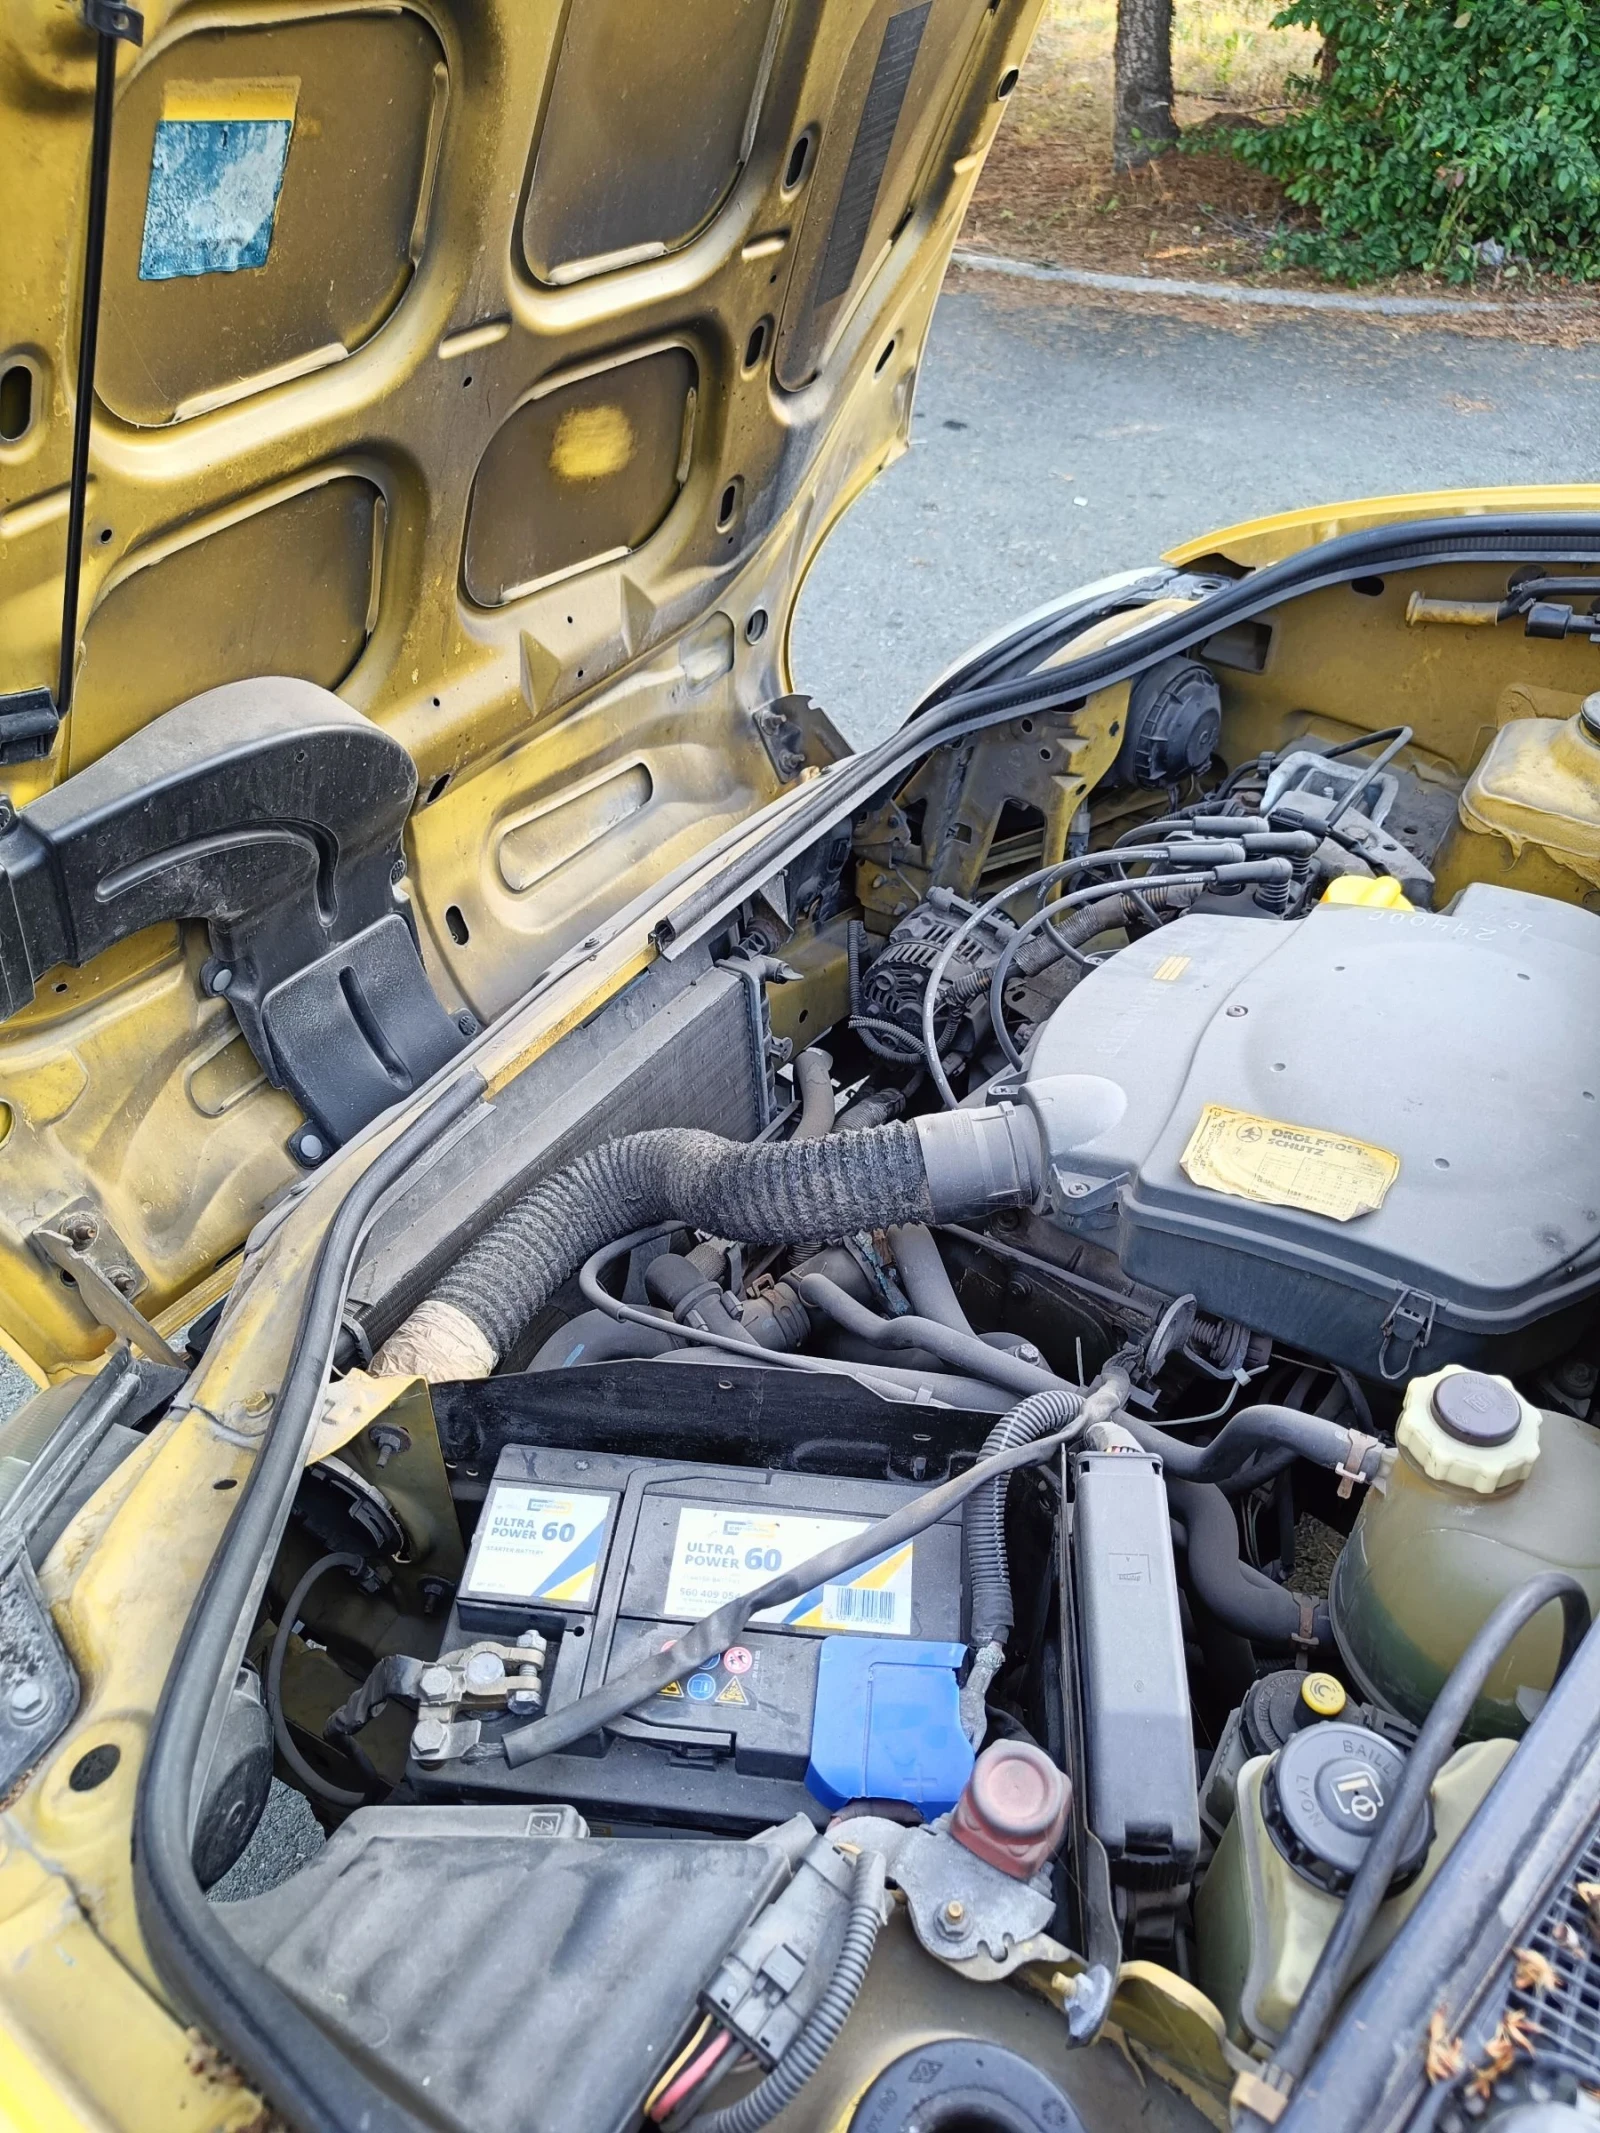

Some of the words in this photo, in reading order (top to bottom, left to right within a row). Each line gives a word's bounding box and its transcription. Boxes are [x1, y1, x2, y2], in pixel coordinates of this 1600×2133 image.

[1267, 1138, 1325, 1157] SCHUTZ
[494, 1517, 534, 1529] ULTRA
[541, 1522, 576, 1542] 60
[491, 1528, 537, 1540] POWER
[687, 1542, 735, 1555] ULTRA
[684, 1554, 740, 1569] POWER
[744, 1547, 783, 1571] 60
[1342, 1740, 1393, 1775] BAILL
[1296, 1772, 1325, 1829] LYON
